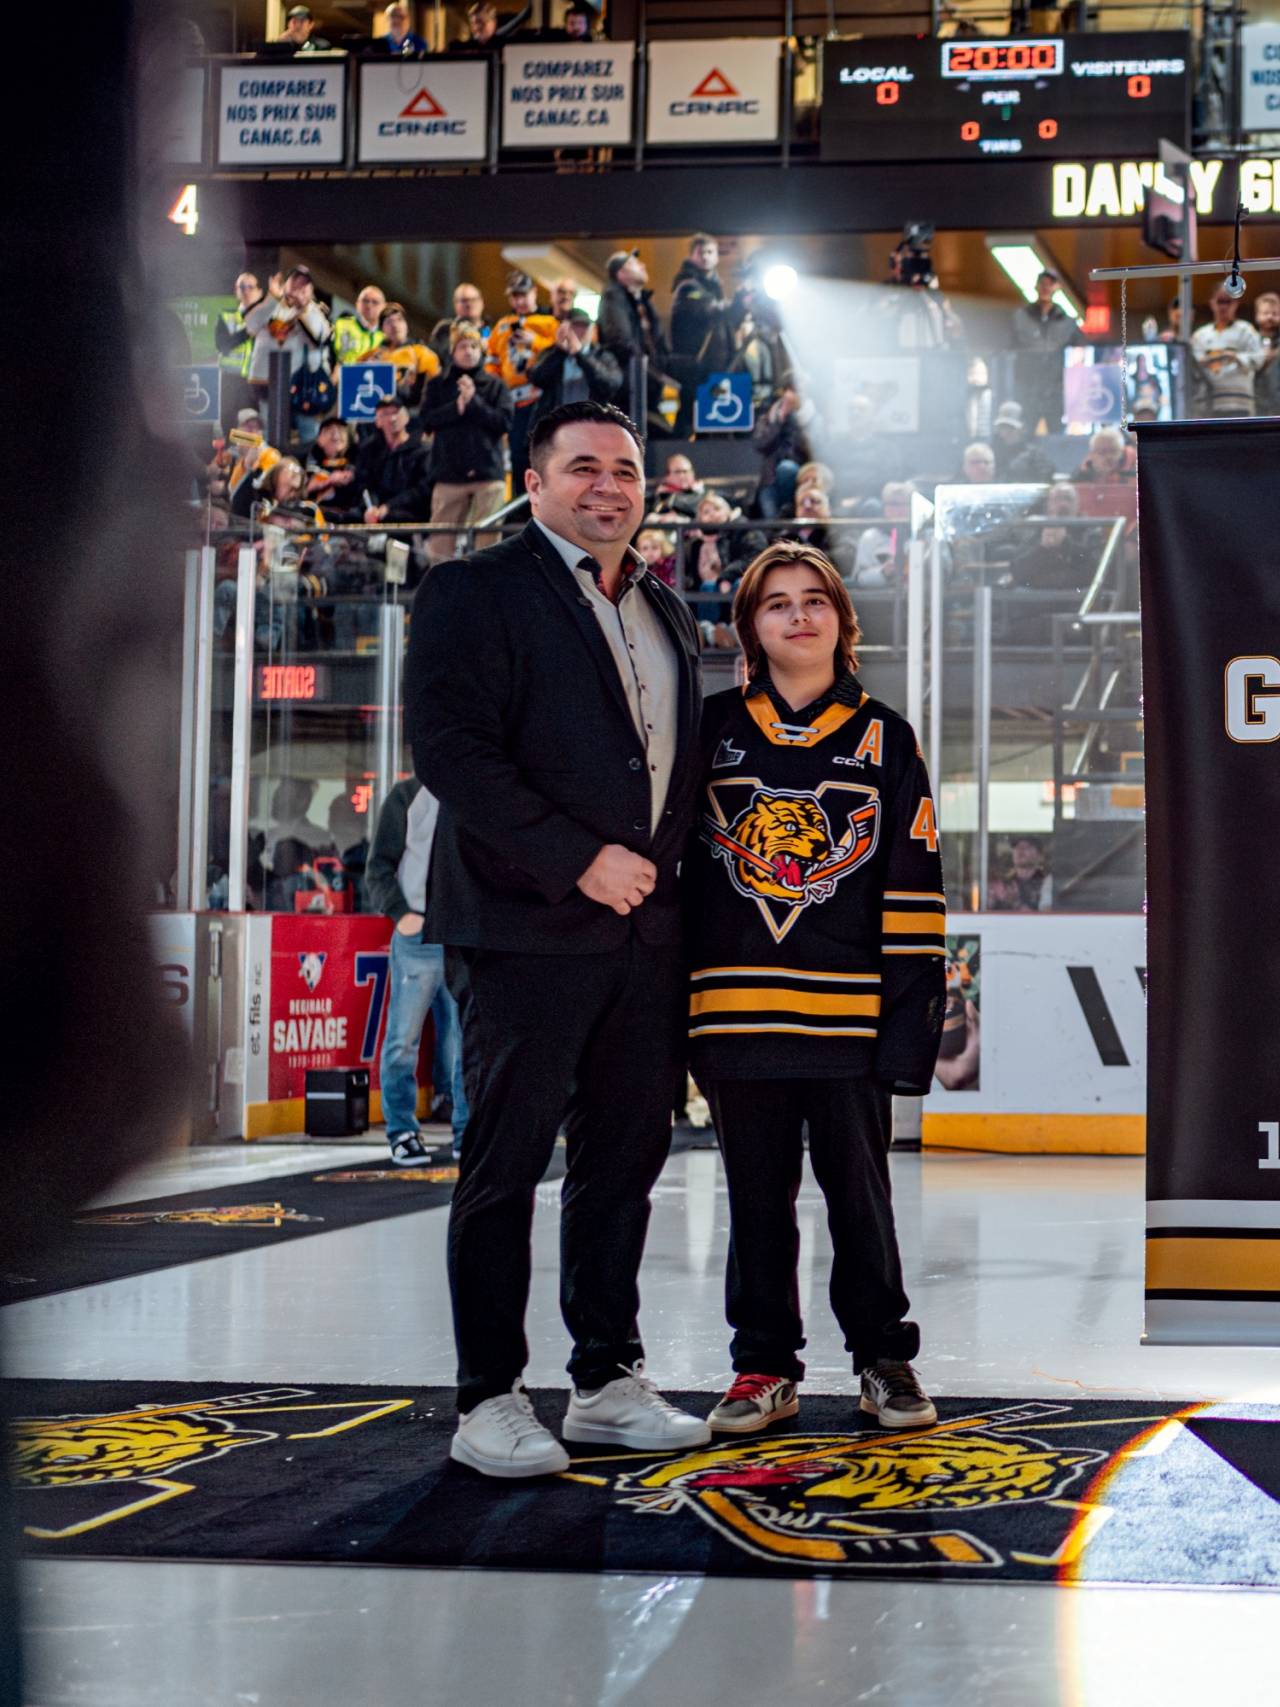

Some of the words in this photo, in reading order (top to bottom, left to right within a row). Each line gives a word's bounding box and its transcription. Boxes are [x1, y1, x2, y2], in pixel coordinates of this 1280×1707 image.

[950, 45, 1056, 71] 20:00
[1071, 59, 1185, 77] VISITEURS
[523, 60, 614, 80] COMPAREZ
[840, 66, 914, 84] LOCAL
[239, 79, 327, 98] COMPAREZ
[510, 85, 543, 103] NOS
[548, 85, 586, 102] PRIX
[592, 84, 625, 101] SUR
[876, 81, 900, 105] 0
[1127, 75, 1151, 99] 0
[227, 104, 257, 123] NOS
[262, 104, 300, 122] PRIX
[304, 103, 337, 121] SUR
[524, 109, 610, 127] CANAC.CA
[668, 100, 759, 117] CANAC
[239, 127, 322, 146] CANAC.CA
[377, 120, 467, 137] CANAC
[960, 121, 981, 141] 0
[1038, 119, 1058, 140] 0
[1052, 160, 1223, 217] DANY
[168, 184, 199, 235] 4
[854, 718, 884, 767] A
[910, 797, 939, 852] 4
[289, 997, 333, 1016] REGINALD
[273, 1016, 348, 1053] SAVAGE
